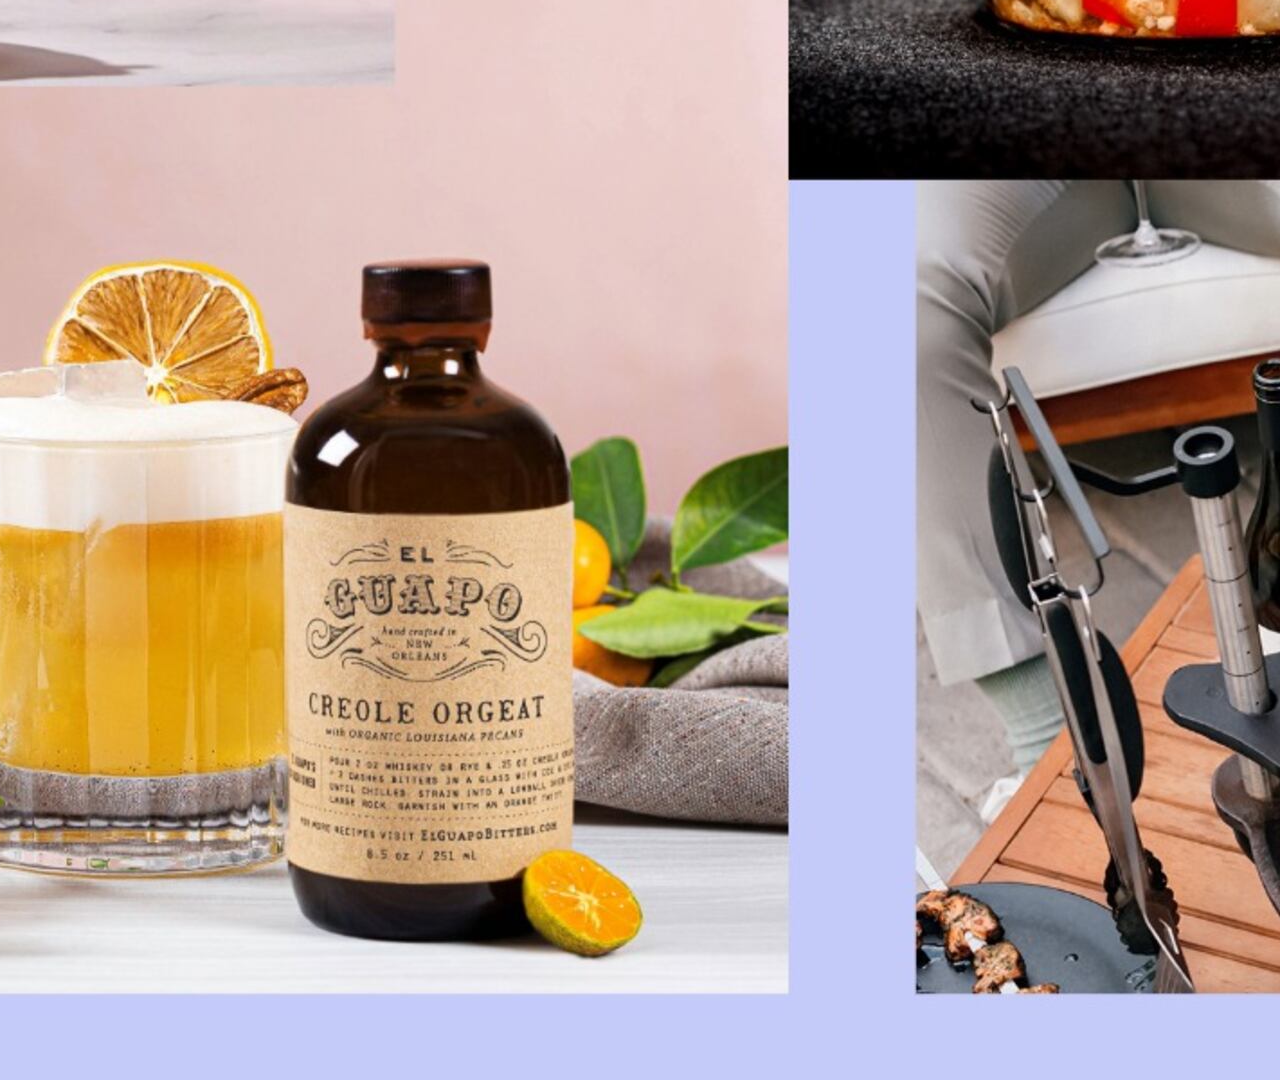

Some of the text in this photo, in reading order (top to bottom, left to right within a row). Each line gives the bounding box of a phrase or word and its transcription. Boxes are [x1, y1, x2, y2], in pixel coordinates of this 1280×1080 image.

[400, 546, 435, 563] EL
[324, 573, 523, 622] GUAPO
[381, 625, 457, 637] hand crafted in
[406, 639, 433, 649] NEW
[391, 651, 448, 661] ORLEANS
[309, 691, 545, 725] CREOLE ORGEAT
[325, 726, 524, 743] with ORGANIC LOUISIANA PECANS
[385, 762, 433, 772] WHISKEY
[460, 762, 480, 772] RYE
[348, 772, 385, 784] DASHES
[392, 775, 438, 786] BITTERS
[446, 777, 459, 785] IN
[465, 776, 473, 784] A
[478, 773, 510, 784] GLASS
[329, 782, 356, 794] UNTIL
[418, 789, 460, 798] STRAIN
[466, 788, 492, 798] INTO
[498, 787, 504, 795] A
[397, 802, 446, 811] GARNISH
[452, 802, 480, 811] WITH
[485, 800, 498, 810] AN
[312, 820, 331, 834] MORE
[334, 825, 376, 839] RECIPES
[380, 830, 415, 841] VISIT
[395, 852, 410, 861] oz
[433, 850, 455, 861] 251
